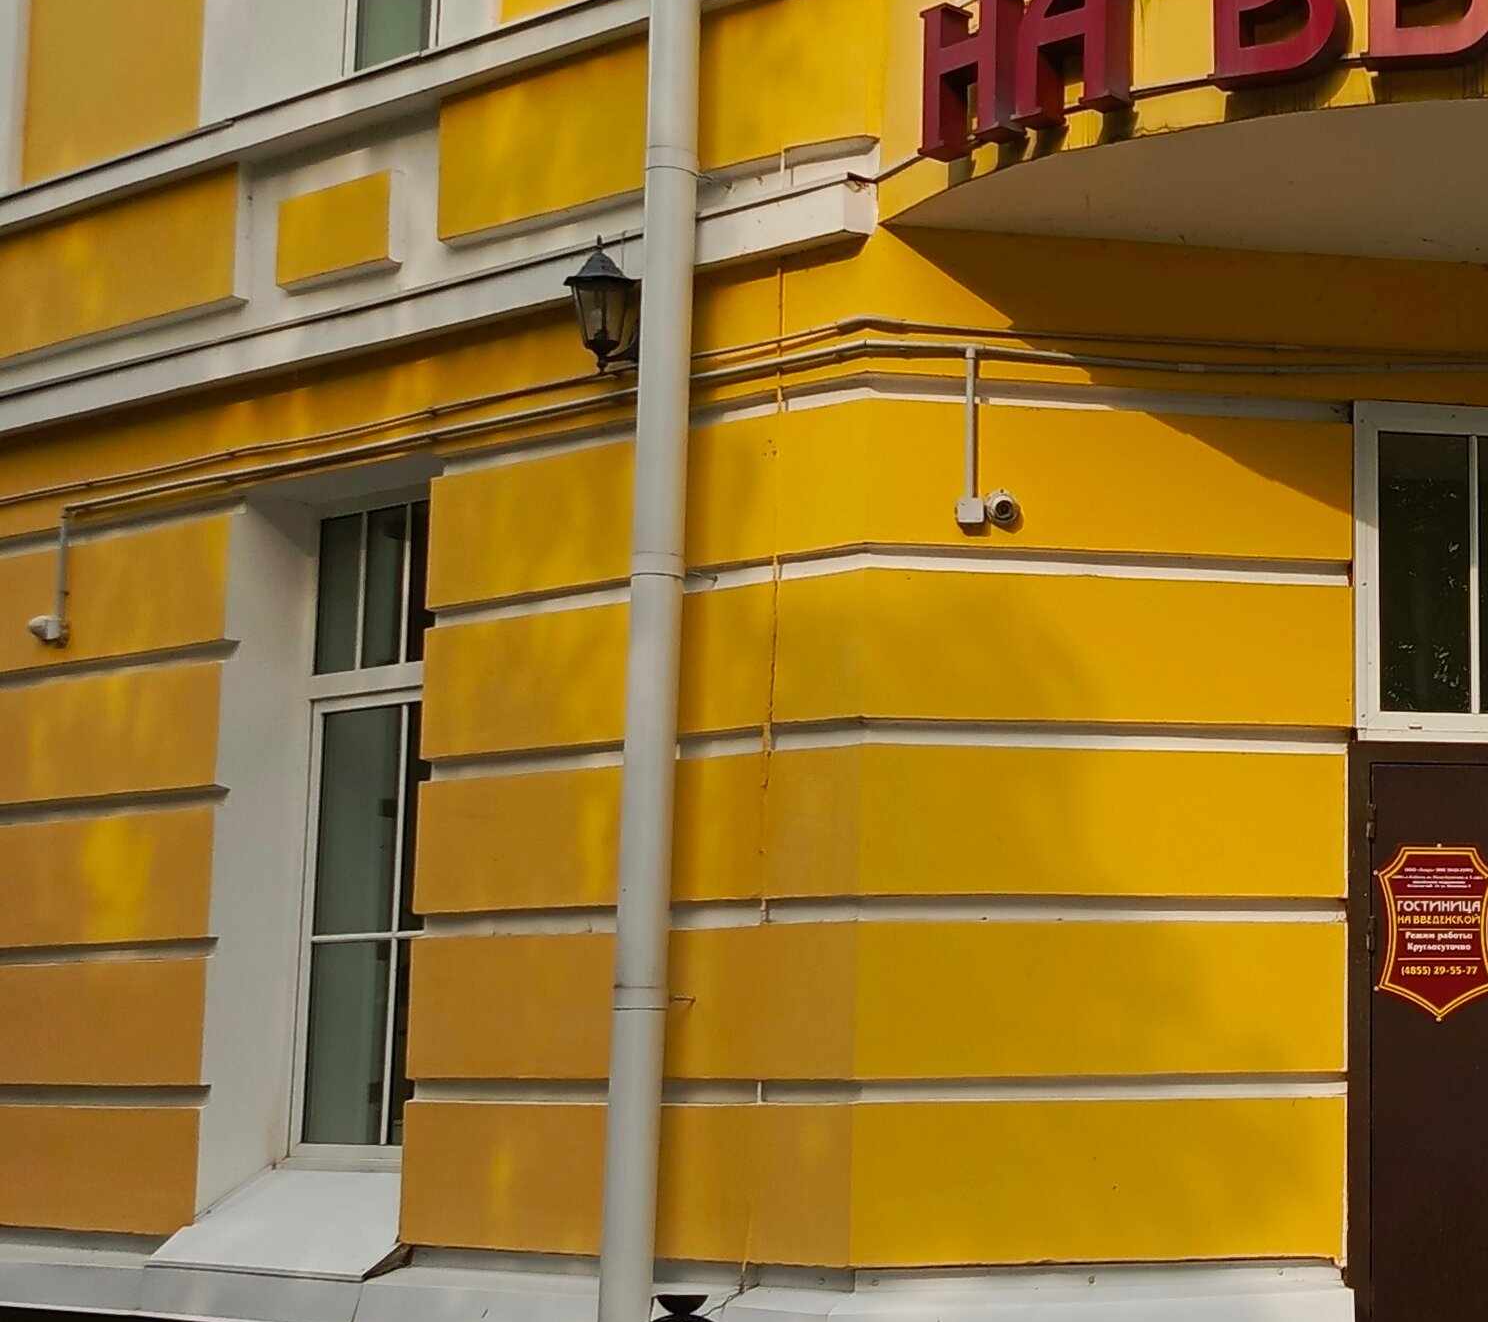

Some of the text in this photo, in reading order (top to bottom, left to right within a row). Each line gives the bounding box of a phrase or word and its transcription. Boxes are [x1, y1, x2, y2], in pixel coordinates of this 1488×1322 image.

[1397, 900, 1481, 914] ГОСТИНИЦА
[1397, 913, 1481, 925] НА ВВЕДЕНСКОЙ
[1405, 931, 1436, 940] Режим
[1406, 942, 1473, 953] Круглосуточно
[1401, 965, 1478, 976] (4855) 29-55-77
